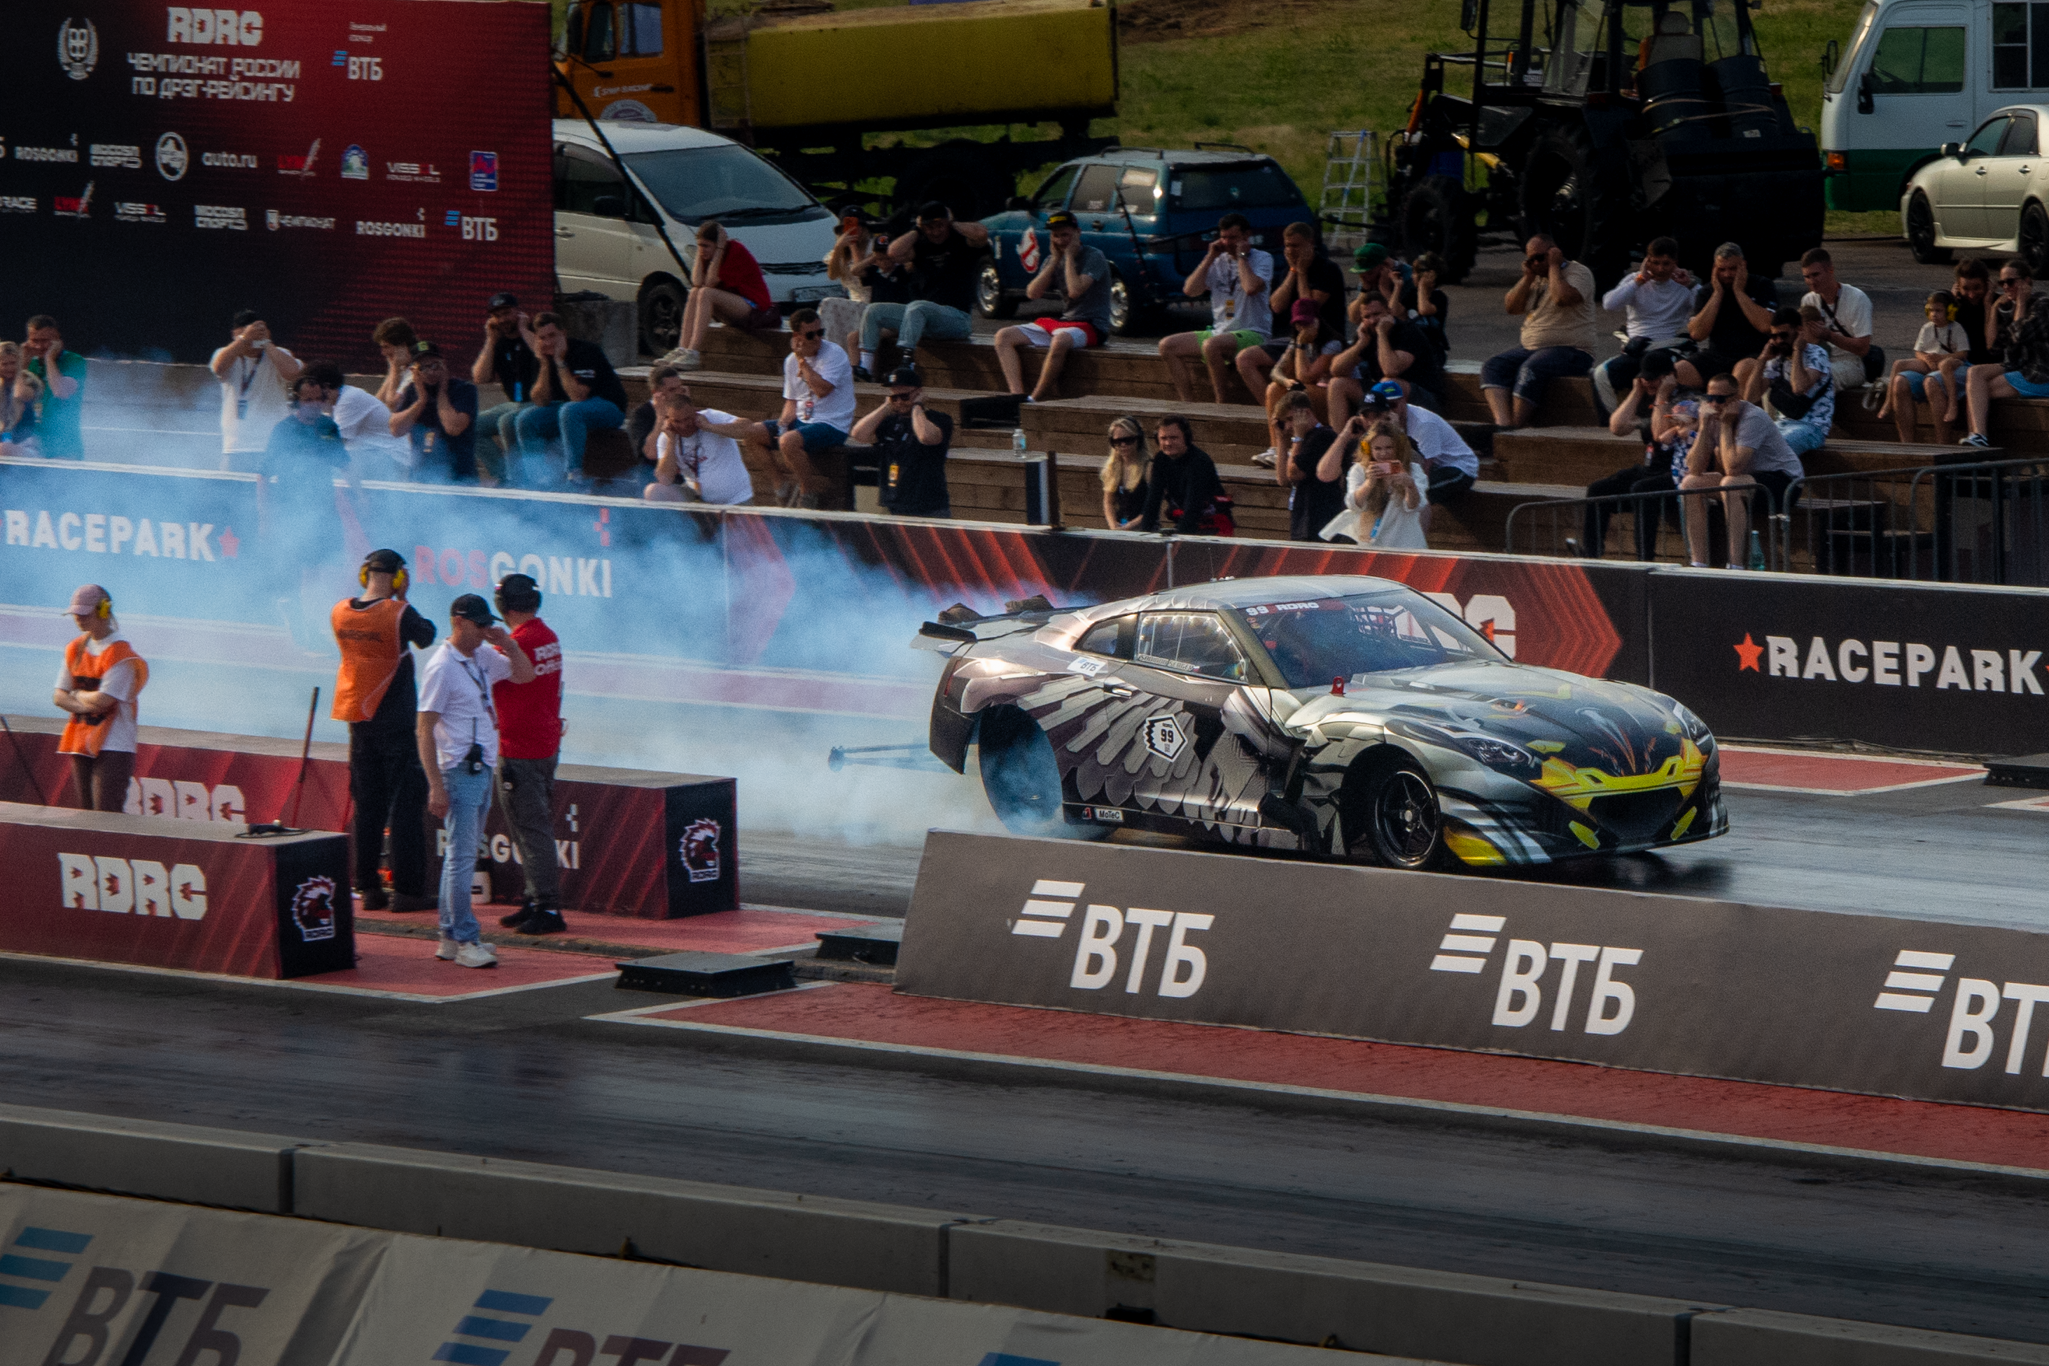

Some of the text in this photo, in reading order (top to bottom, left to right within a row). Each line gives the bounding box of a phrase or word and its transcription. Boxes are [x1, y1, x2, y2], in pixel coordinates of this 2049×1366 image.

[168, 7, 264, 46] RDRC
[127, 53, 300, 79] ЧЕМПИОНАТ РОССИИ
[132, 77, 156, 95] ПО
[348, 56, 383, 80] ВТБ
[462, 216, 498, 241] ВТБ
[4, 510, 216, 562] RACEPARK
[1766, 636, 2045, 695] RACEPARK
[1161, 729, 1174, 743] 99
[58, 853, 208, 921] RDRC
[1070, 904, 1216, 998] ВТБ
[1491, 939, 1644, 1036] ВТБ
[1941, 977, 2049, 1078] ВТ
